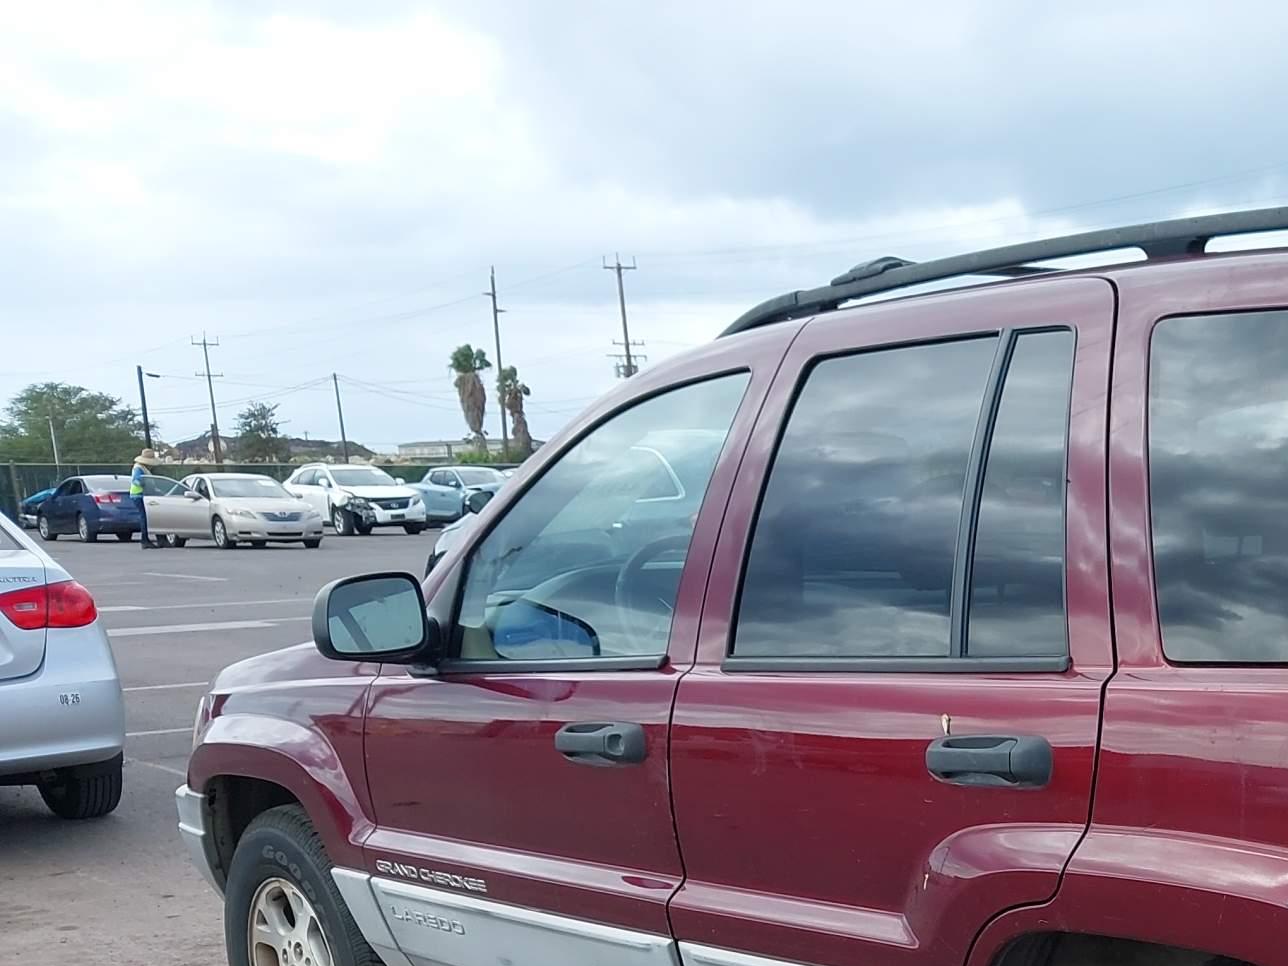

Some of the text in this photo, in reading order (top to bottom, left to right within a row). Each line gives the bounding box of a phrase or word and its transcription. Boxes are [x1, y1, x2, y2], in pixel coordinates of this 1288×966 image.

[375, 859, 488, 893] GRAND CHEROKEE
[391, 905, 466, 936] LAREDO
